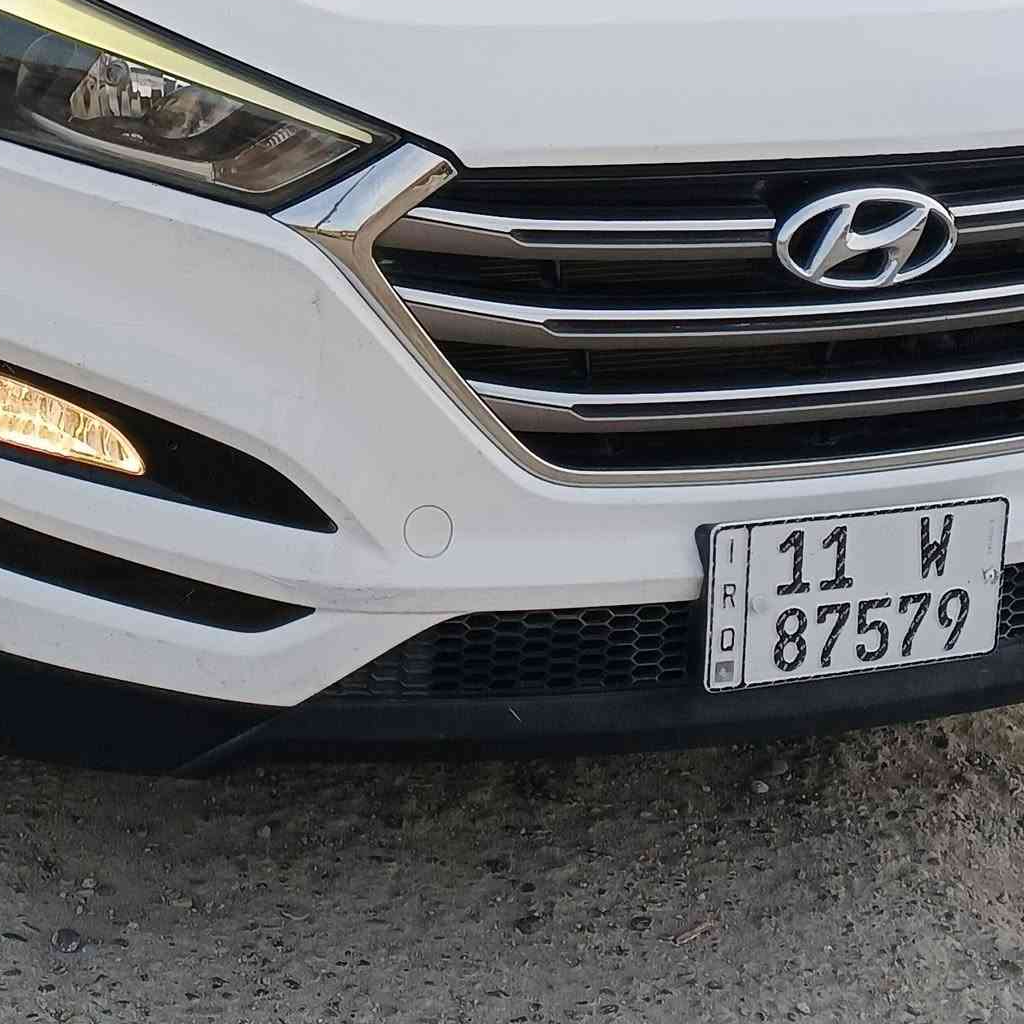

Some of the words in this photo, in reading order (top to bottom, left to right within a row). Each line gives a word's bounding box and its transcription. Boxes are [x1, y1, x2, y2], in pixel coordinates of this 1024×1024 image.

[776, 525, 853, 595] 11
[919, 513, 954, 579] W
[774, 588, 970, 672] 87579
